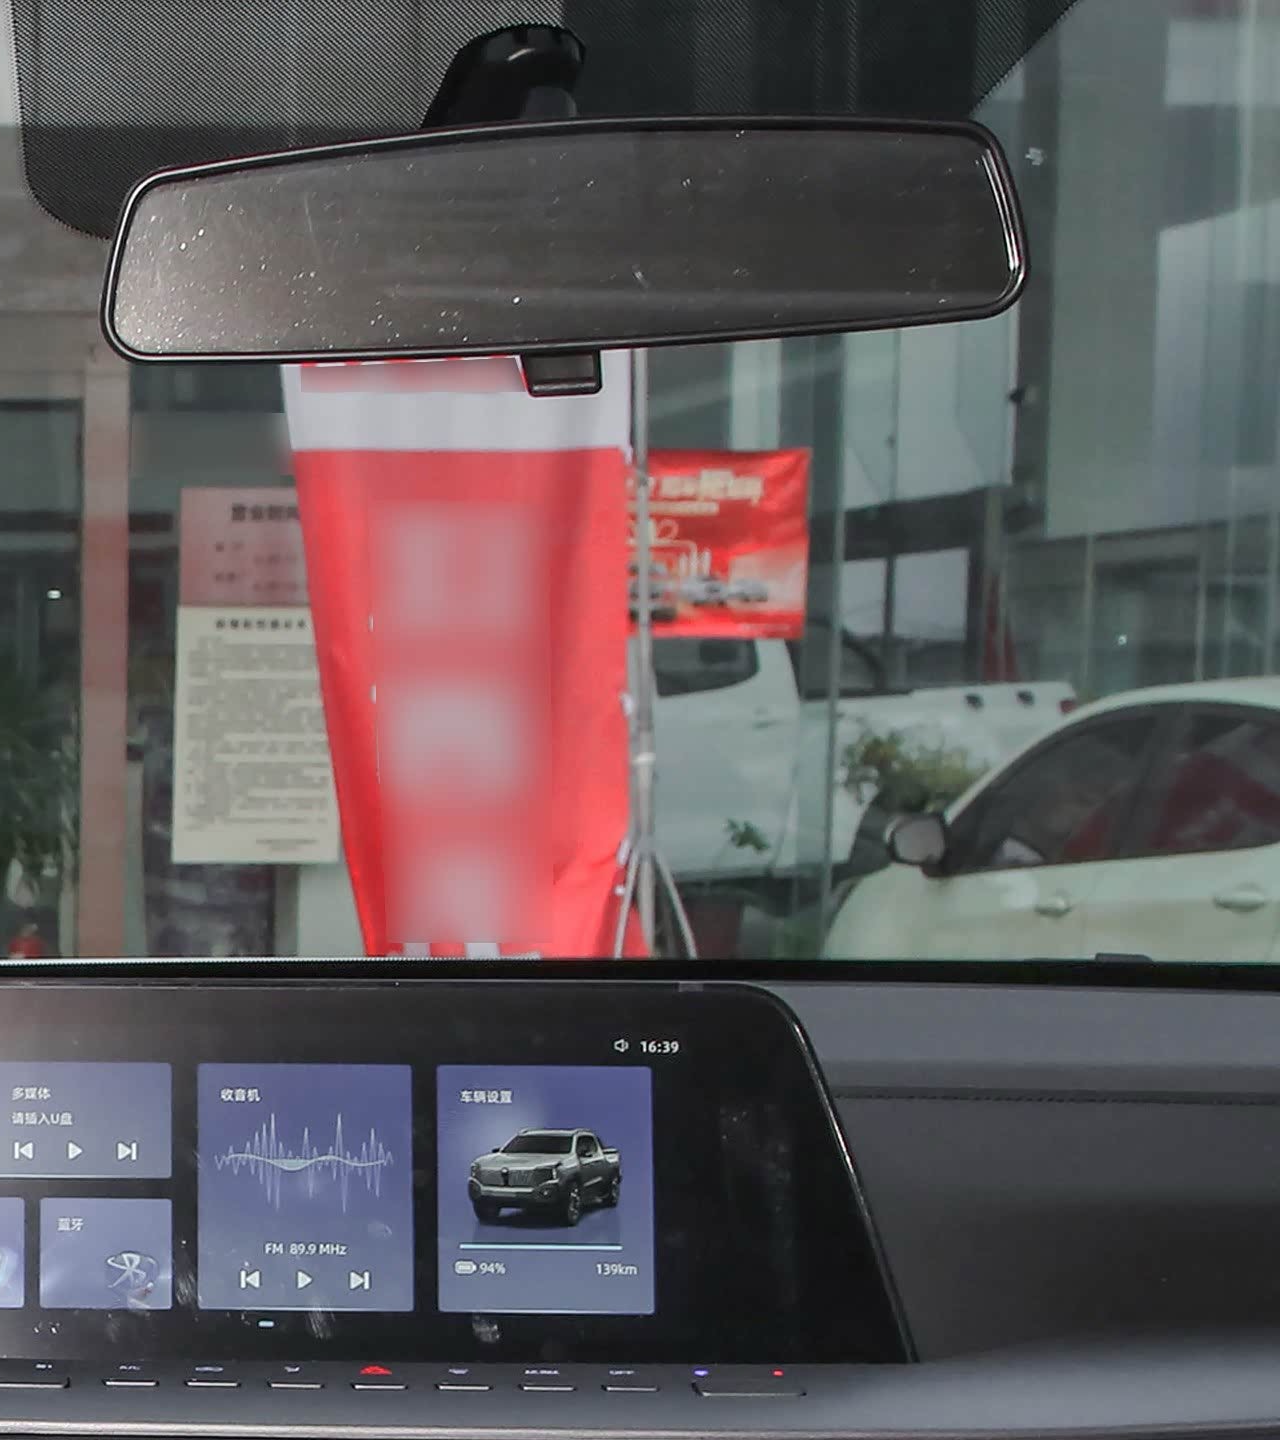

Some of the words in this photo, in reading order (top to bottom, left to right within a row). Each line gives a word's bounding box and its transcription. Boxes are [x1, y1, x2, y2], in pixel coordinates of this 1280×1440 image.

[640, 1040, 680, 1053] 16:39
[11, 1086, 52, 1101] 多媒体
[220, 1088, 261, 1102] 收音机
[460, 1089, 513, 1104] 车辆设置
[11, 1111, 73, 1126] 请插入U盘
[57, 1218, 84, 1231] 蓝牙
[265, 1243, 284, 1255] FM
[290, 1243, 318, 1256] 89.9
[319, 1244, 347, 1256] MHz
[479, 1262, 506, 1275] 94%
[596, 1263, 638, 1276] 139km
